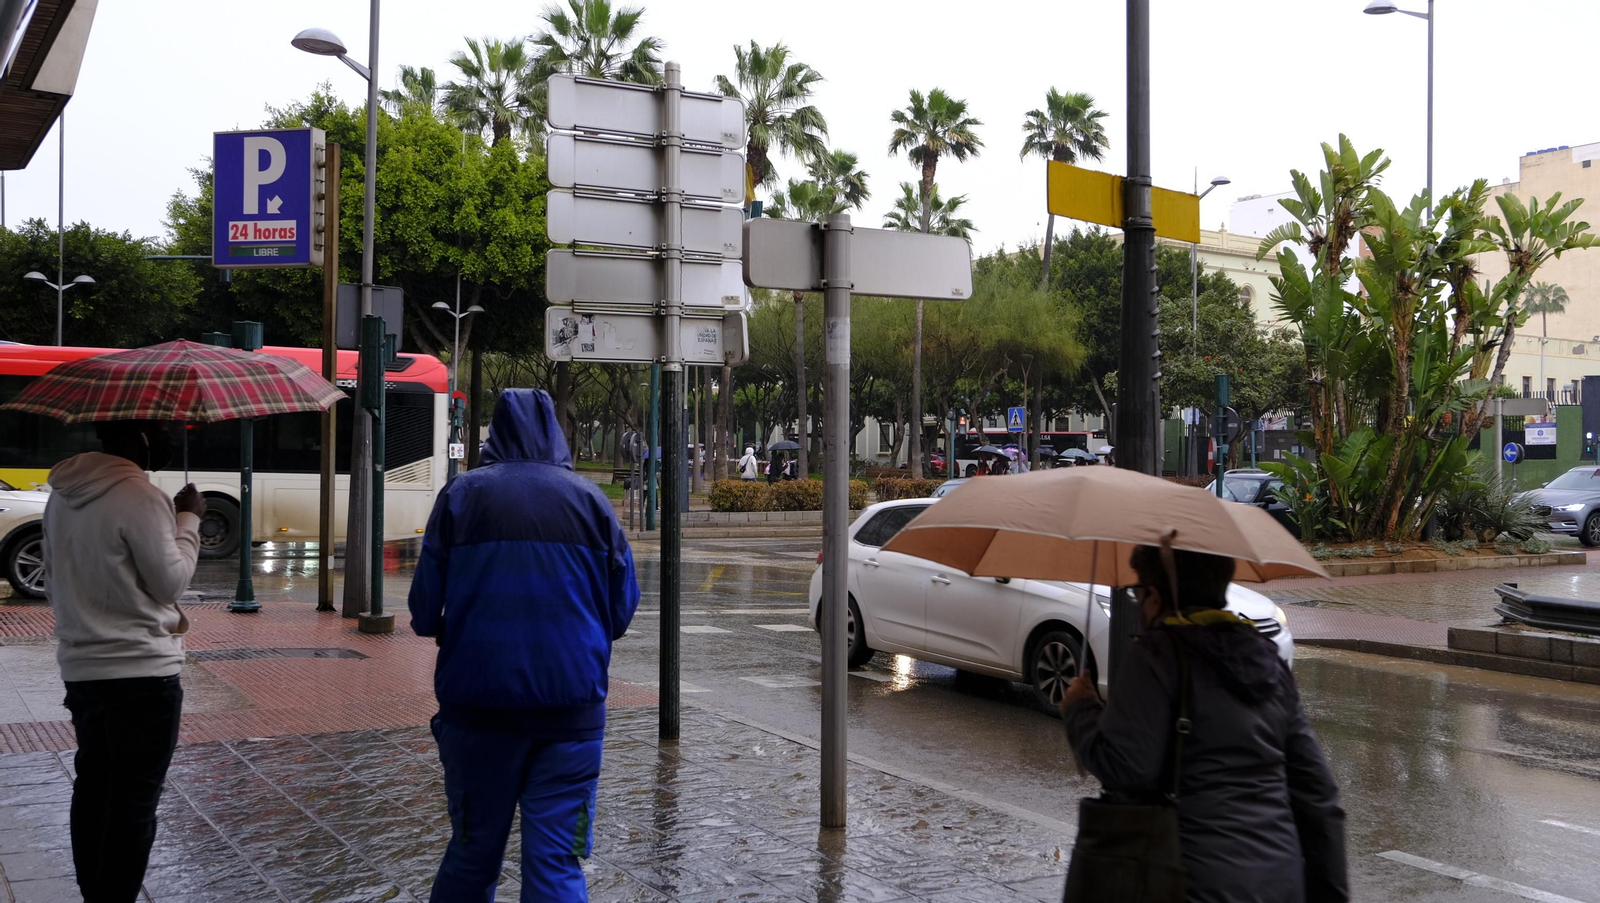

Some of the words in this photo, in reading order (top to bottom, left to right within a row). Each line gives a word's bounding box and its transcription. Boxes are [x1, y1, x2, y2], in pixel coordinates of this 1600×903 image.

[243, 136, 287, 214] P
[230, 224, 249, 240] 24
[253, 222, 295, 240] horas
[253, 248, 279, 257] LIBRE
